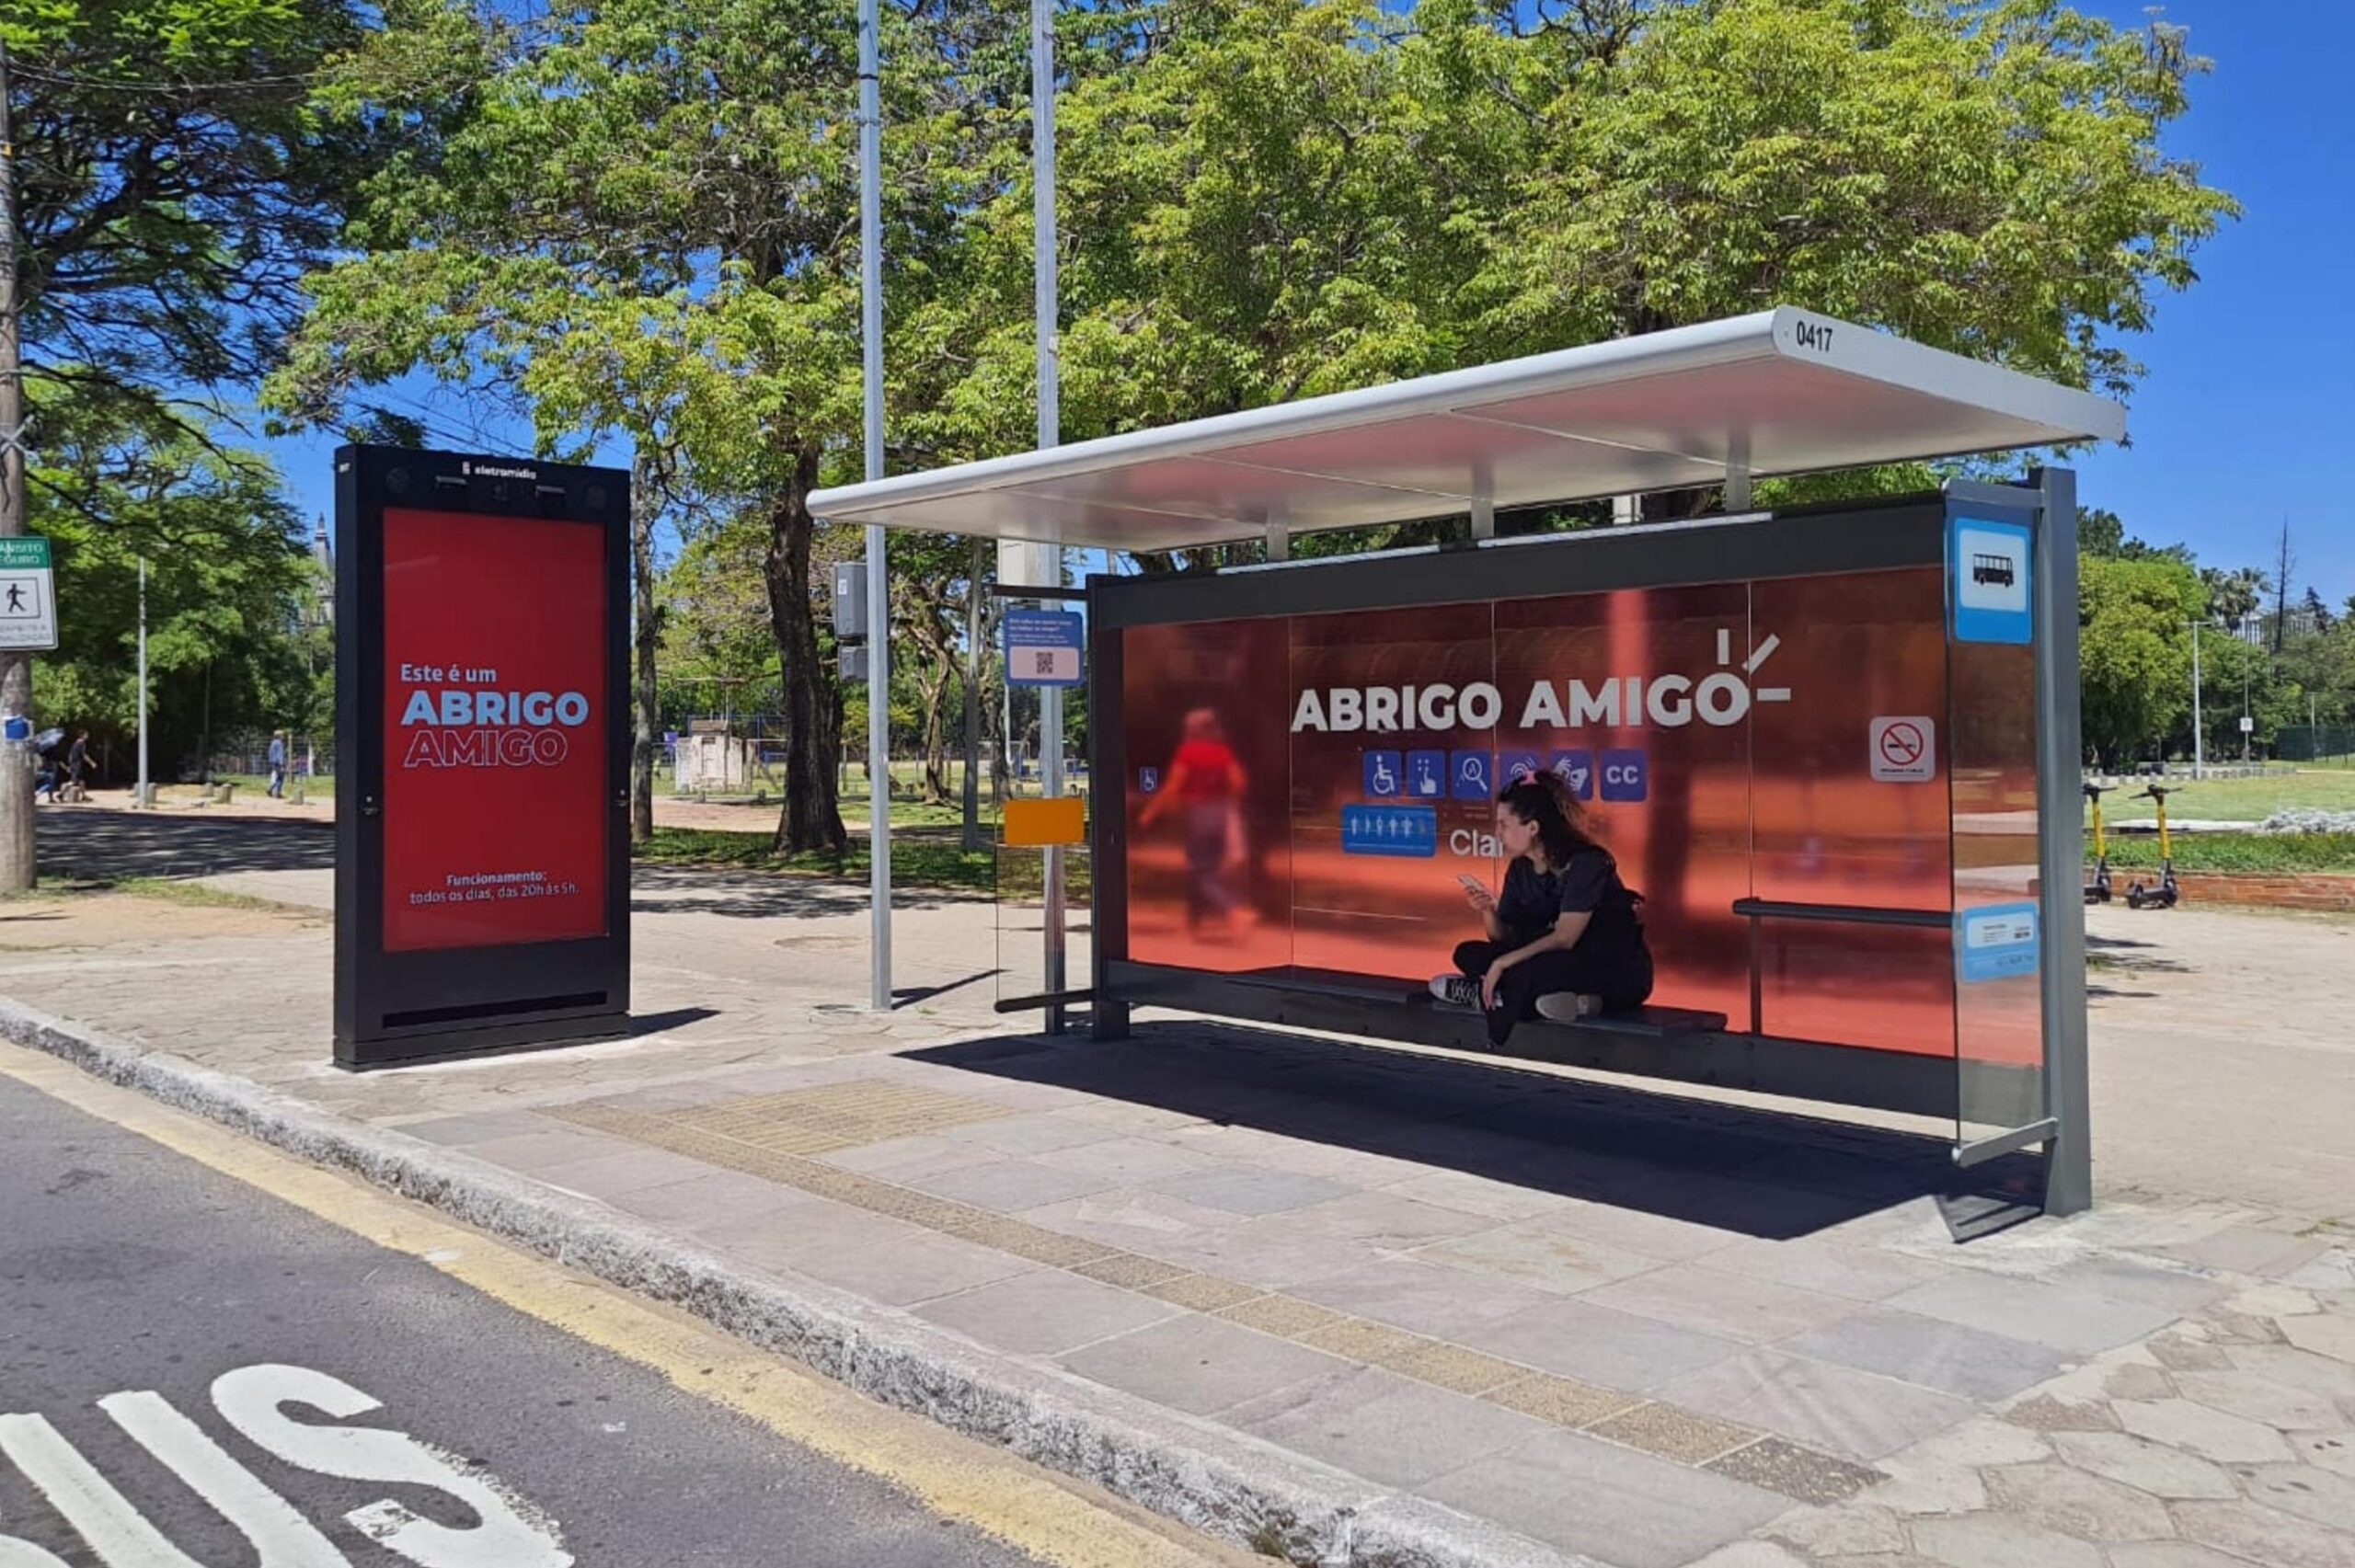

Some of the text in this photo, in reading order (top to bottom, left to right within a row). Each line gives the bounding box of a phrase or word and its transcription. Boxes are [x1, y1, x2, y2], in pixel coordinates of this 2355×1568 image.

[1797, 320, 1832, 352] 0417
[400, 664, 497, 682] Este é um
[400, 690, 589, 726] ABRIGO
[1291, 672, 1751, 733] ABRIGO AMIGO
[404, 728, 568, 767] AMIGO
[409, 891, 446, 904] todos
[449, 891, 462, 902] os
[465, 886, 495, 901] dias,
[498, 885, 519, 898] das
[522, 883, 544, 897] 20h
[446, 871, 547, 887] Funcionamento:
[0, 1363, 576, 1568] US
